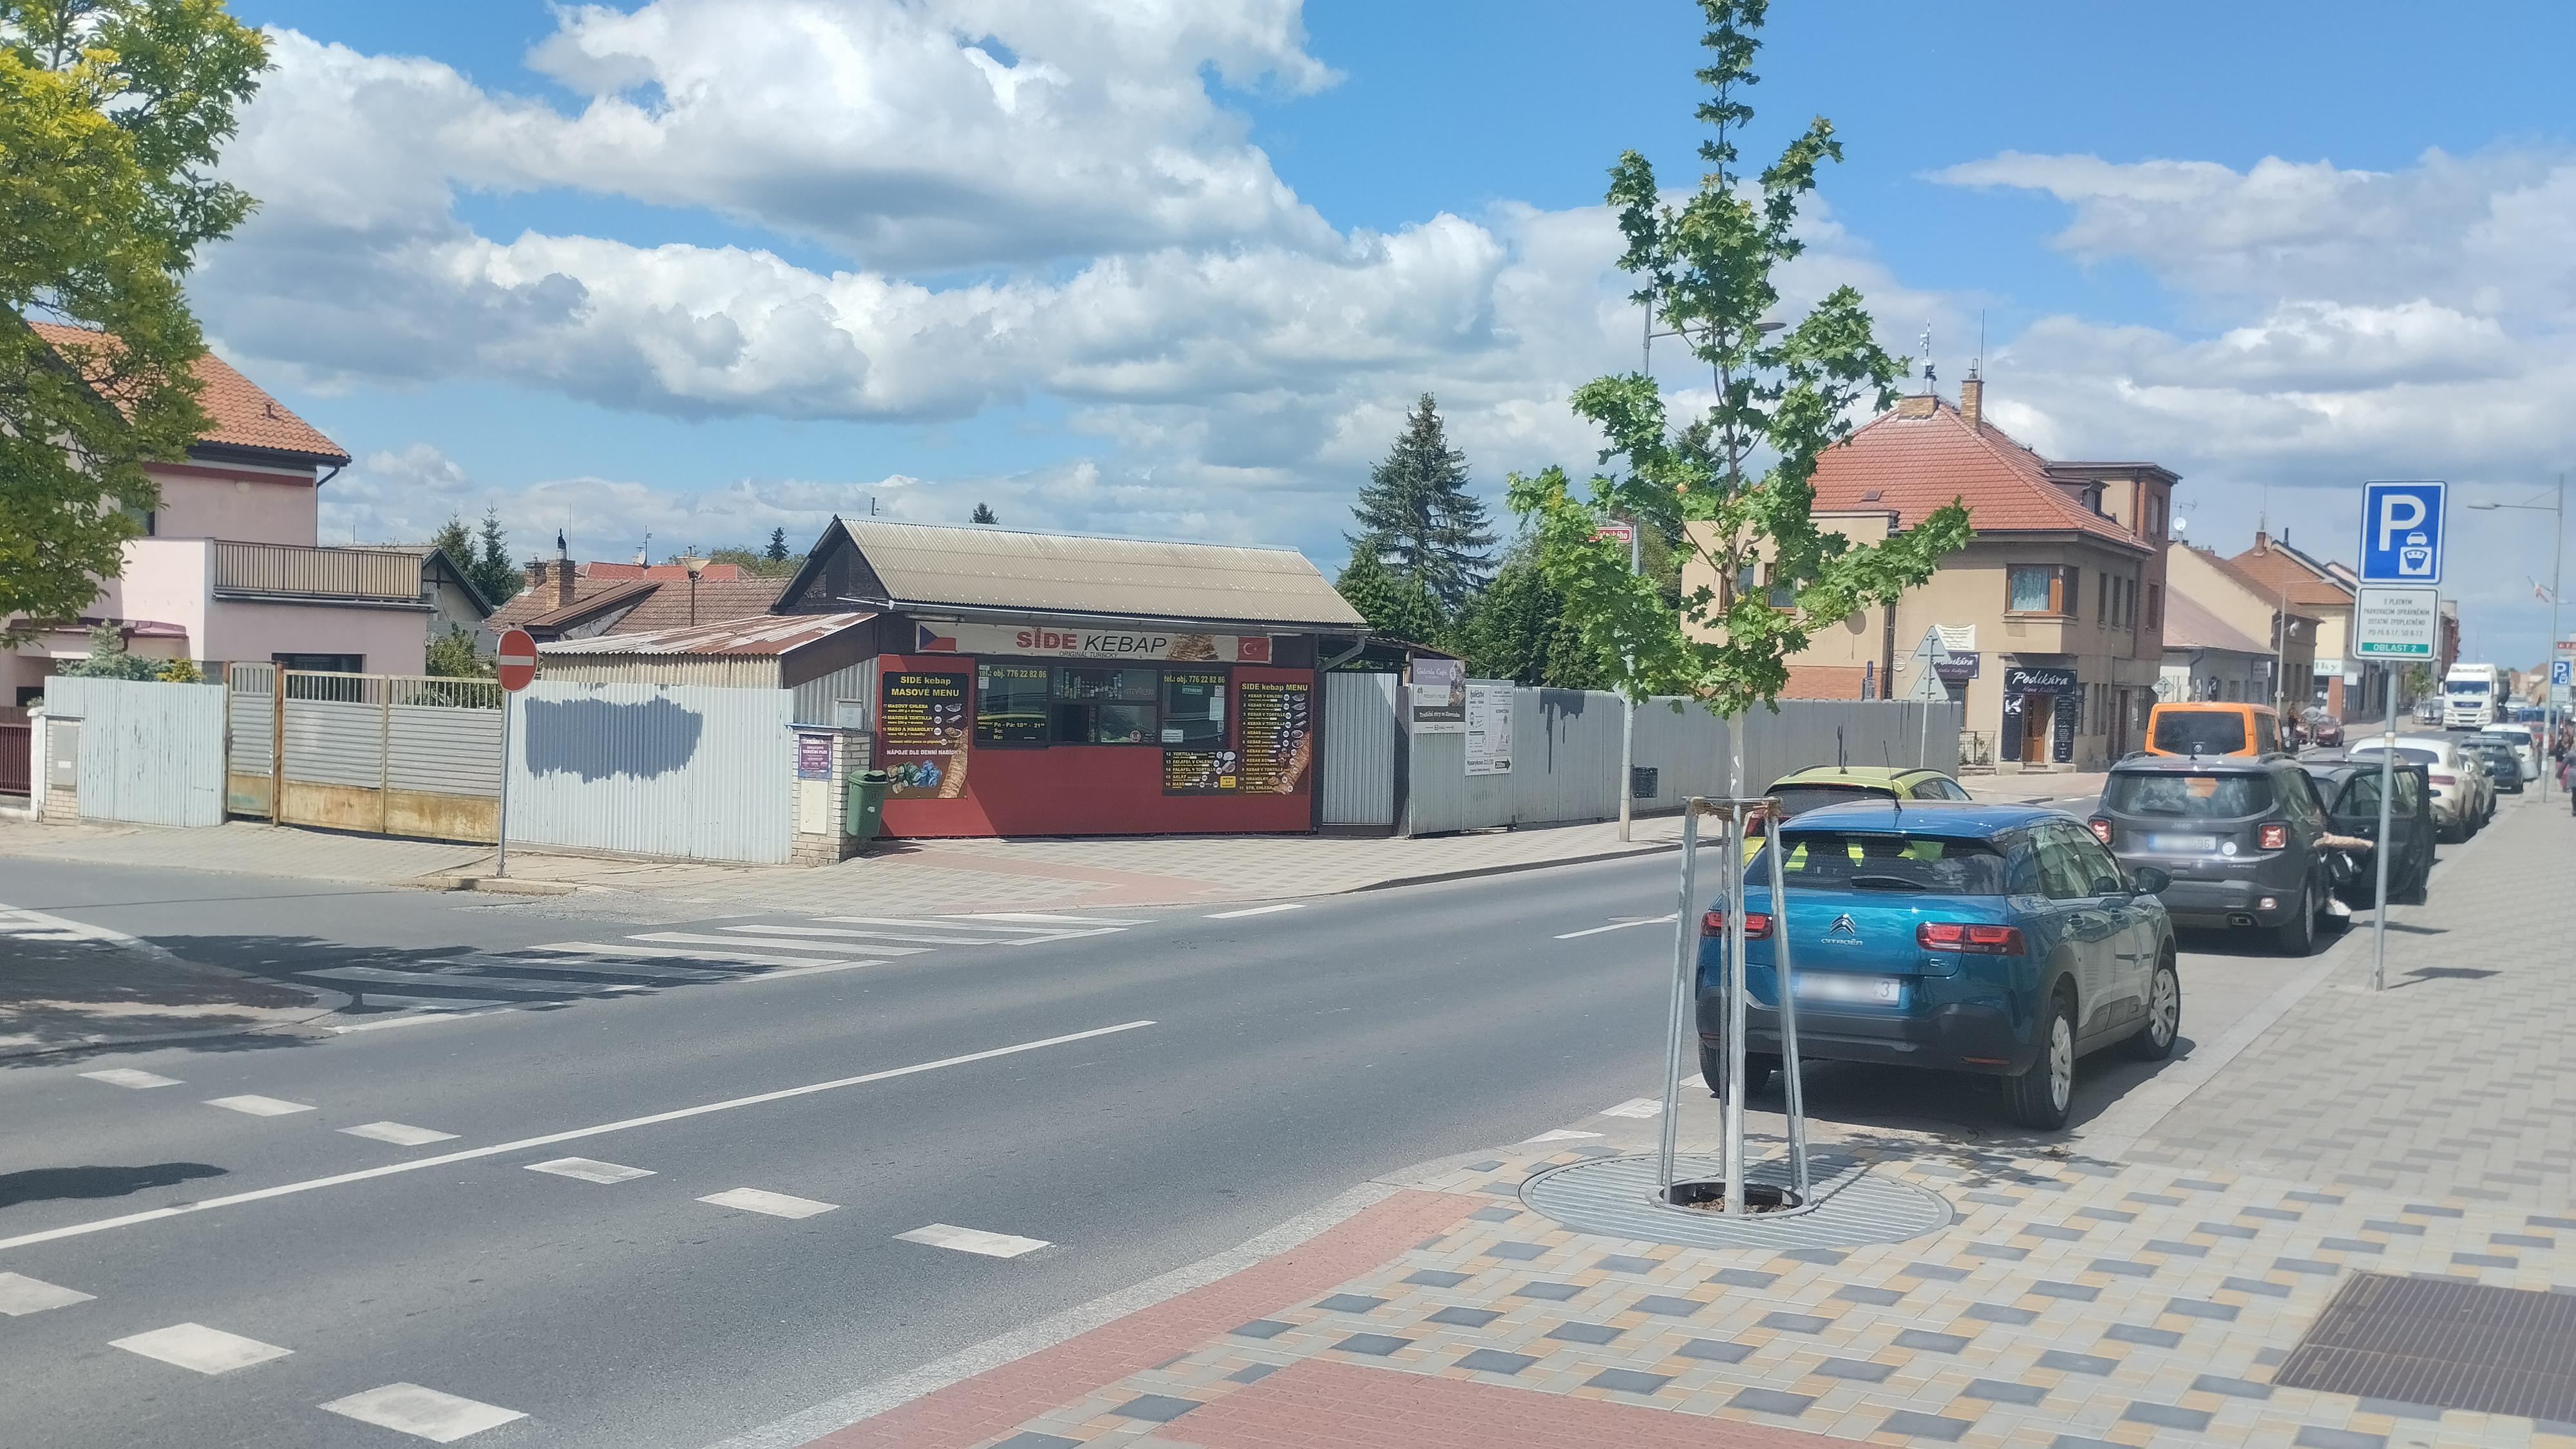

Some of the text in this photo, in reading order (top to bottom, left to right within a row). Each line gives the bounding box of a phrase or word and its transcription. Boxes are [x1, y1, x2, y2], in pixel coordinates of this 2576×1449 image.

[2379, 495, 2426, 551] P
[1084, 635, 1167, 653] KEBAP
[993, 670, 1005, 679] obj.
[2554, 663, 2566, 678] P
[924, 677, 951, 686] kebap
[1177, 675, 1188, 684] obj.
[891, 687, 931, 696] MASOVÉ
[1262, 684, 1284, 692] kebap
